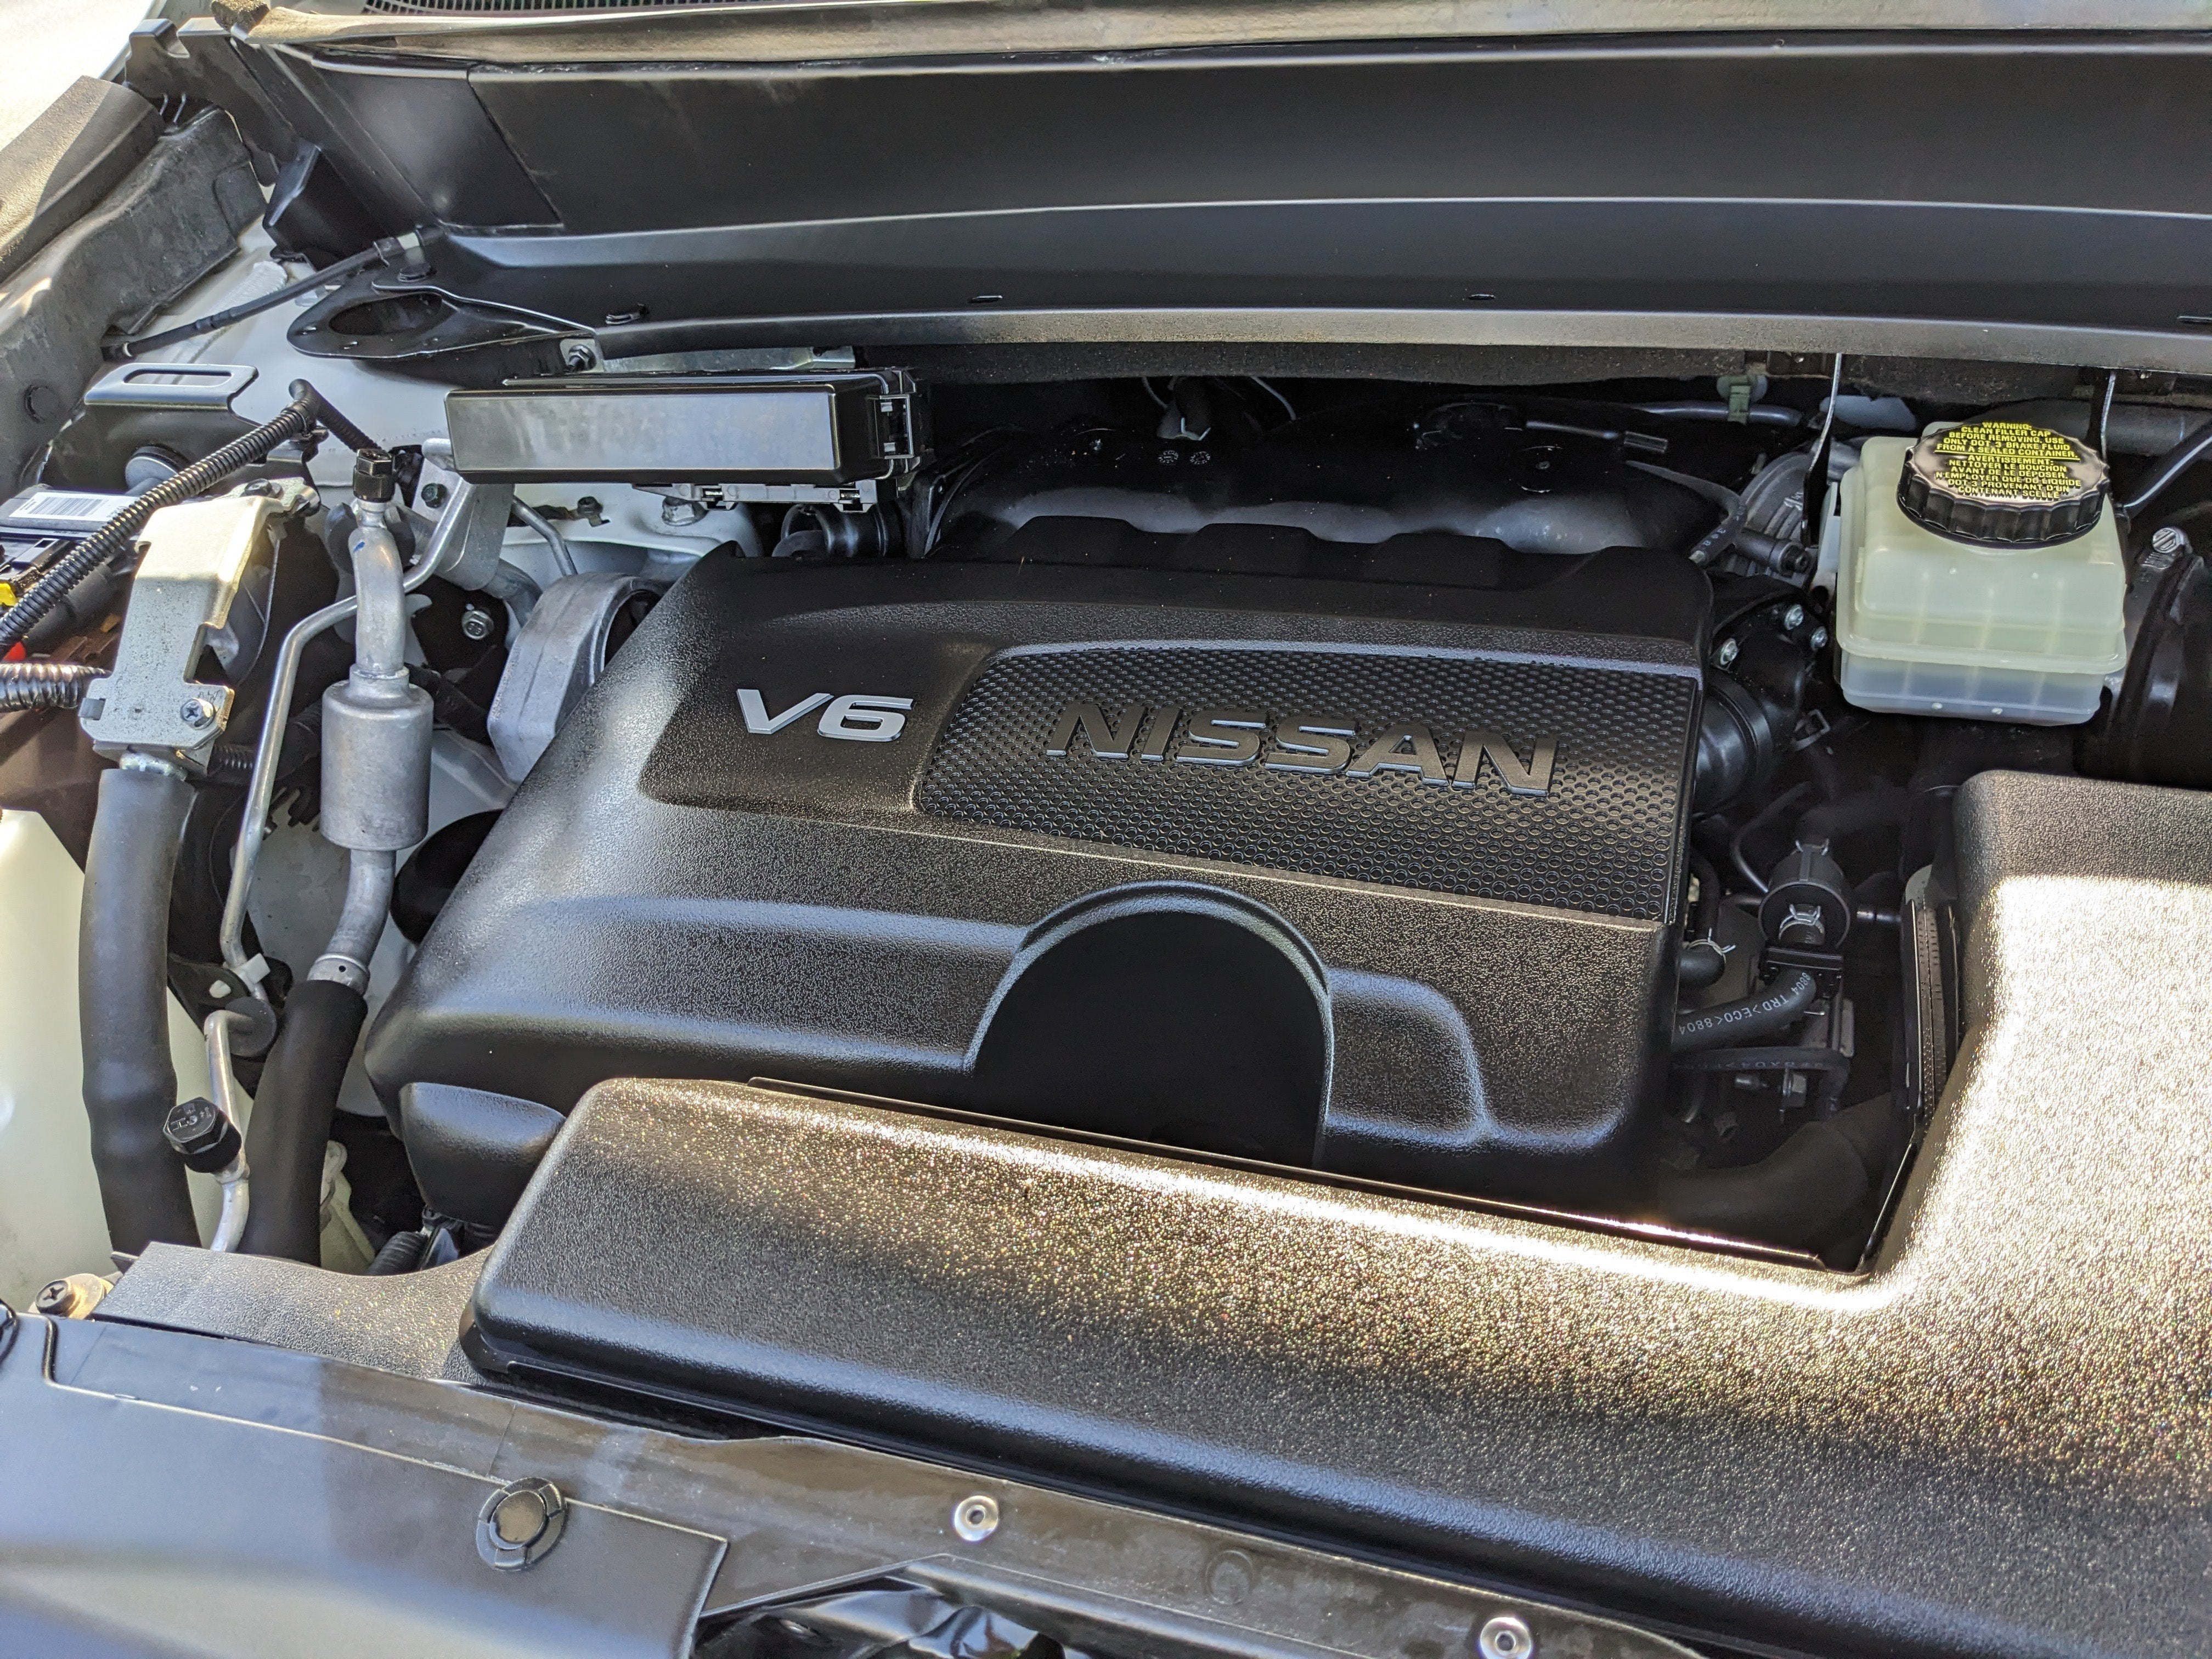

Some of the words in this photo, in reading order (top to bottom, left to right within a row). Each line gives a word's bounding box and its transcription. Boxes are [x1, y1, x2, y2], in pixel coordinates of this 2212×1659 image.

[1982, 422, 2032, 431] WARNING:
[1943, 437, 1968, 445] ONLY
[2006, 442, 2039, 450] BRAKE
[1949, 432, 1986, 440] BEFORE
[1988, 434, 2042, 443] REMOVING.
[1937, 443, 1965, 452] FROM
[1978, 447, 2016, 455] SEALED
[2018, 449, 2078, 458] CONTAINER.
[1949, 459, 2001, 470] NETTOYER
[2019, 464, 2067, 472] BOUCHON
[1967, 455, 2054, 466] AVERTISSEMENT:
[1951, 466, 1985, 475] AVANT
[1935, 472, 1999, 482] N'EMPLOYER
[2041, 478, 2082, 487] LIQUIDE
[1957, 486, 2018, 496] CONTENANT
[1981, 481, 2043, 491] PROVENANT
[2046, 484, 2070, 493] D'UN
[736, 689, 914, 742] V6
[1046, 703, 1559, 796] NISSAN
[1791, 972, 1811, 996] 8804
